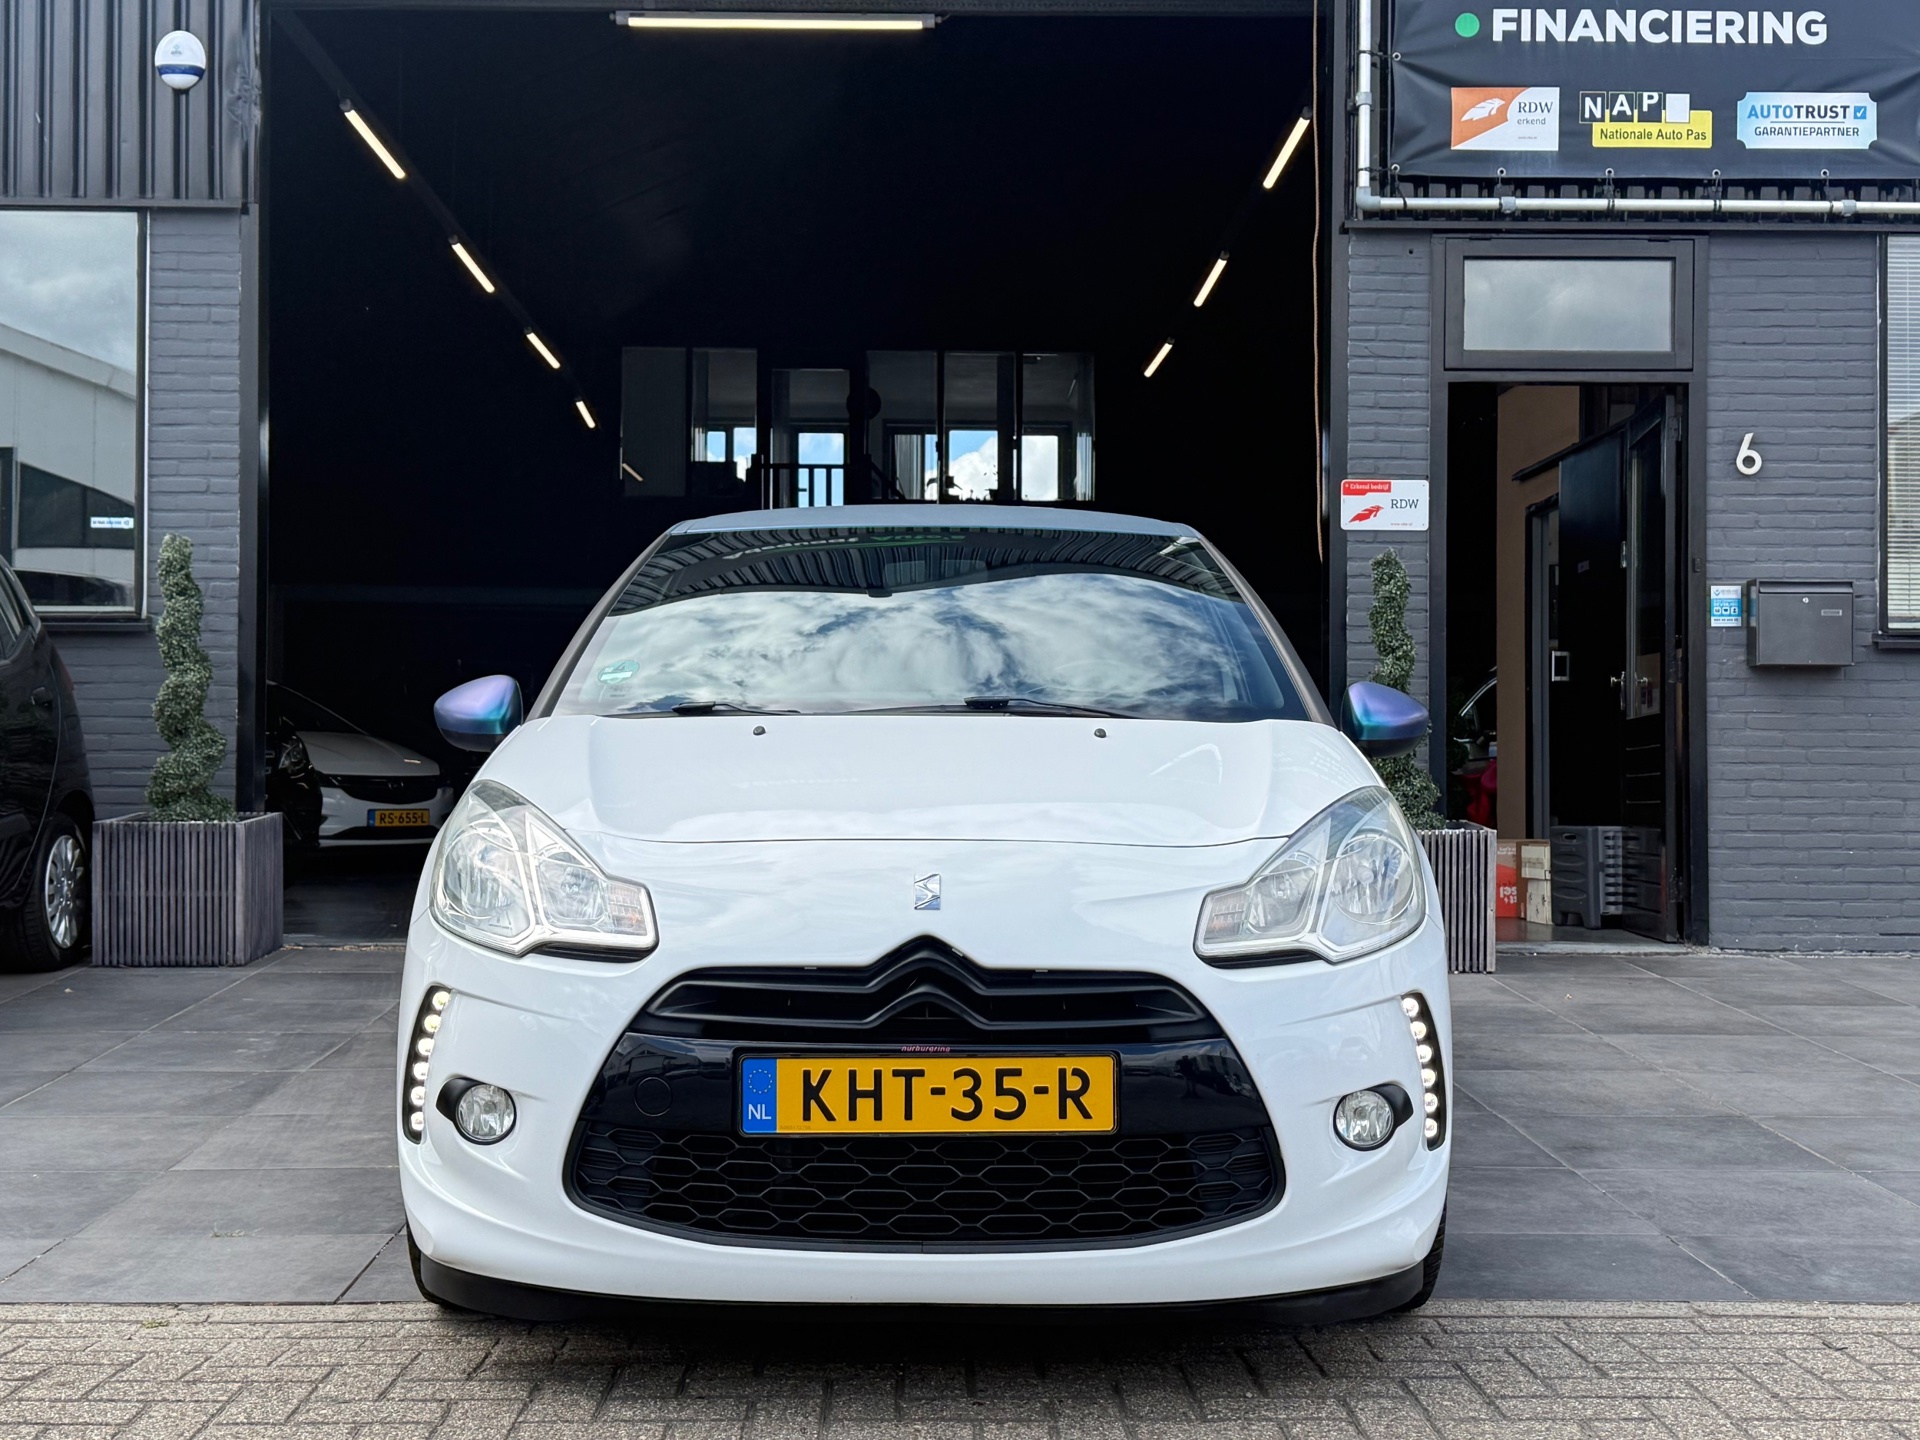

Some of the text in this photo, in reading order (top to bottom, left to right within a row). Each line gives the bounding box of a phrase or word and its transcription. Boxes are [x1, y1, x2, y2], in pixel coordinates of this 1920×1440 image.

[1492, 8, 1828, 45] FINANCIERING
[1517, 101, 1554, 113] RDW
[1747, 104, 1851, 119] AUTOTRUST
[1517, 117, 1546, 125] erkend
[1600, 128, 1707, 141] Nationale Auto Pas
[1754, 126, 1860, 137] GARANTIEPARTNER
[1736, 432, 1763, 475] 6
[1390, 498, 1420, 509] RDW
[802, 1067, 1094, 1122] KHT-35-R
[747, 1103, 772, 1120] NL
